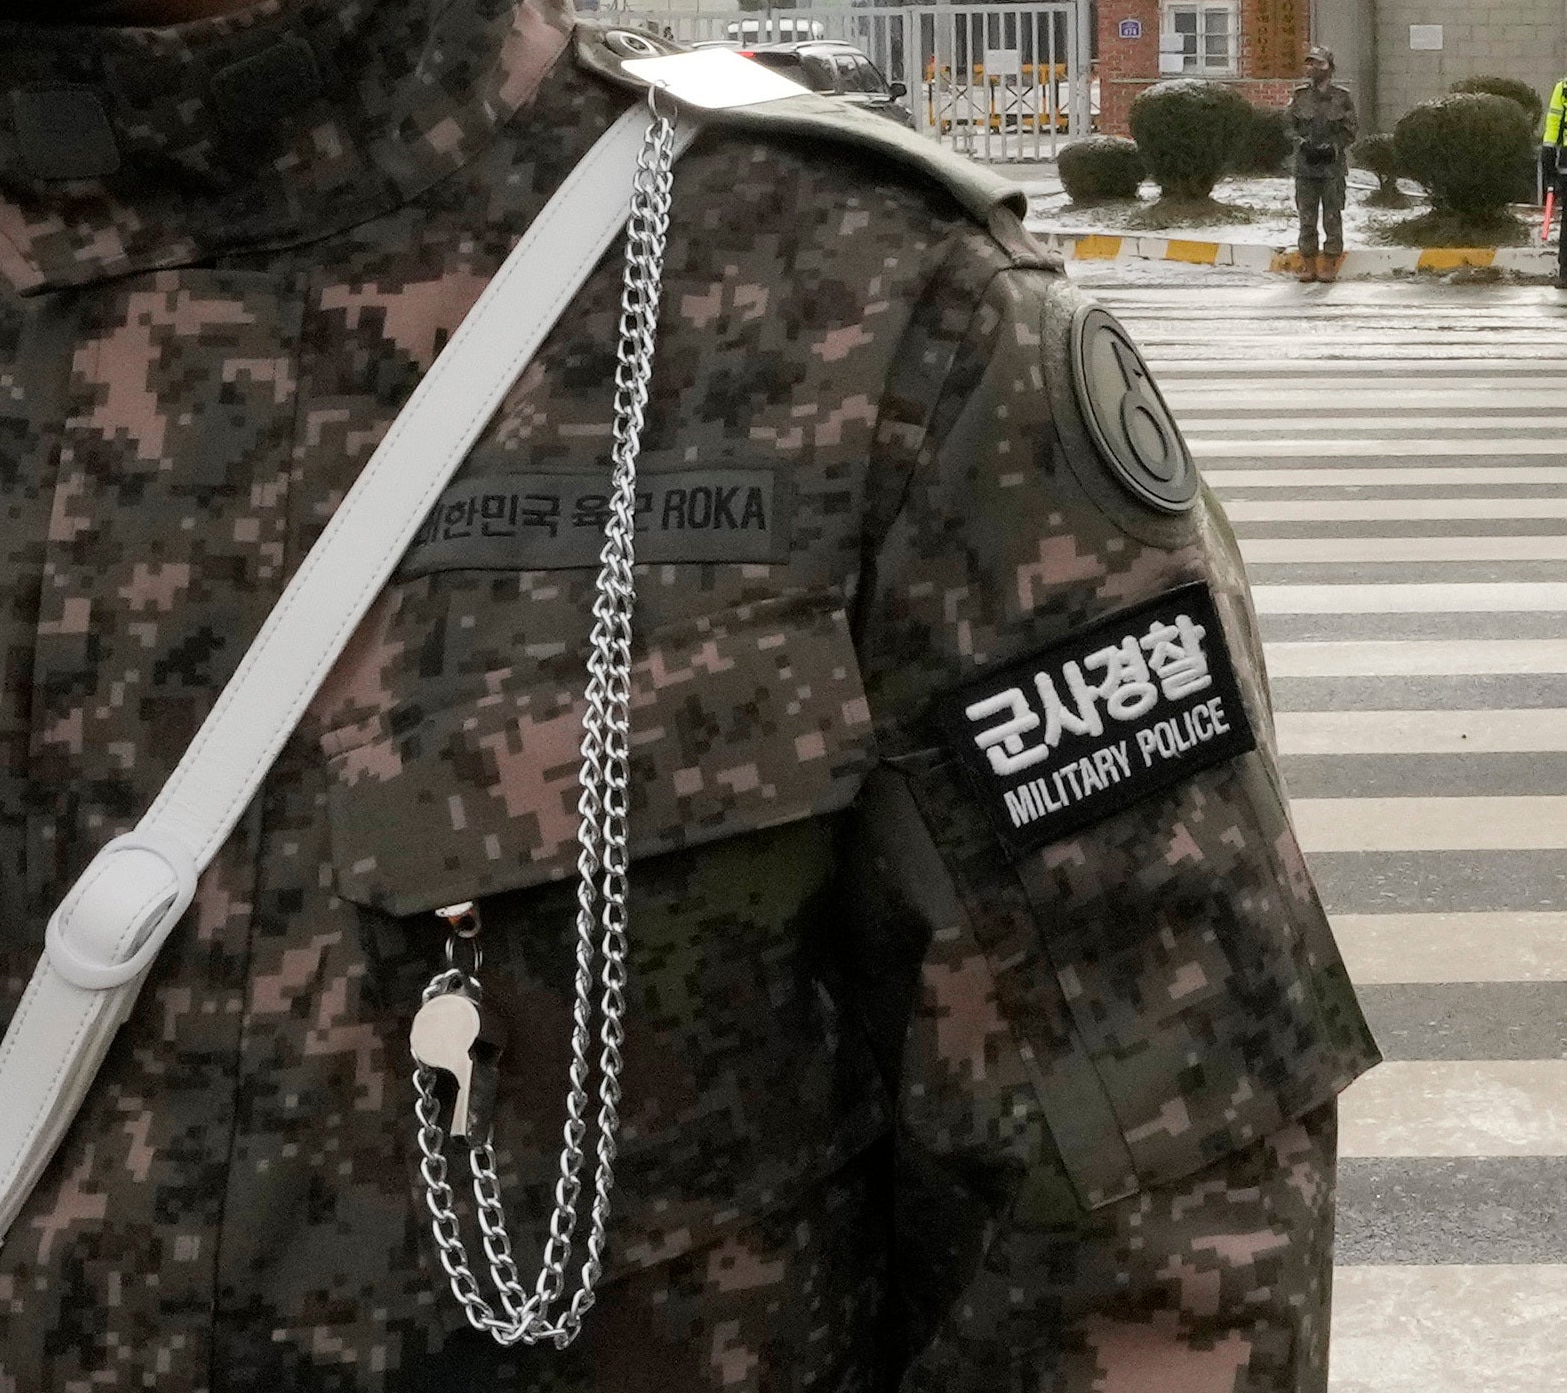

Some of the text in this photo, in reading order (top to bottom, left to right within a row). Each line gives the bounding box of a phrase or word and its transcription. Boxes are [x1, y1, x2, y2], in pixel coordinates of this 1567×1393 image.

[662, 486, 766, 531] ROKA
[965, 614, 1213, 776] 군사경찰
[1003, 696, 1232, 829] MILITARY POLICE
